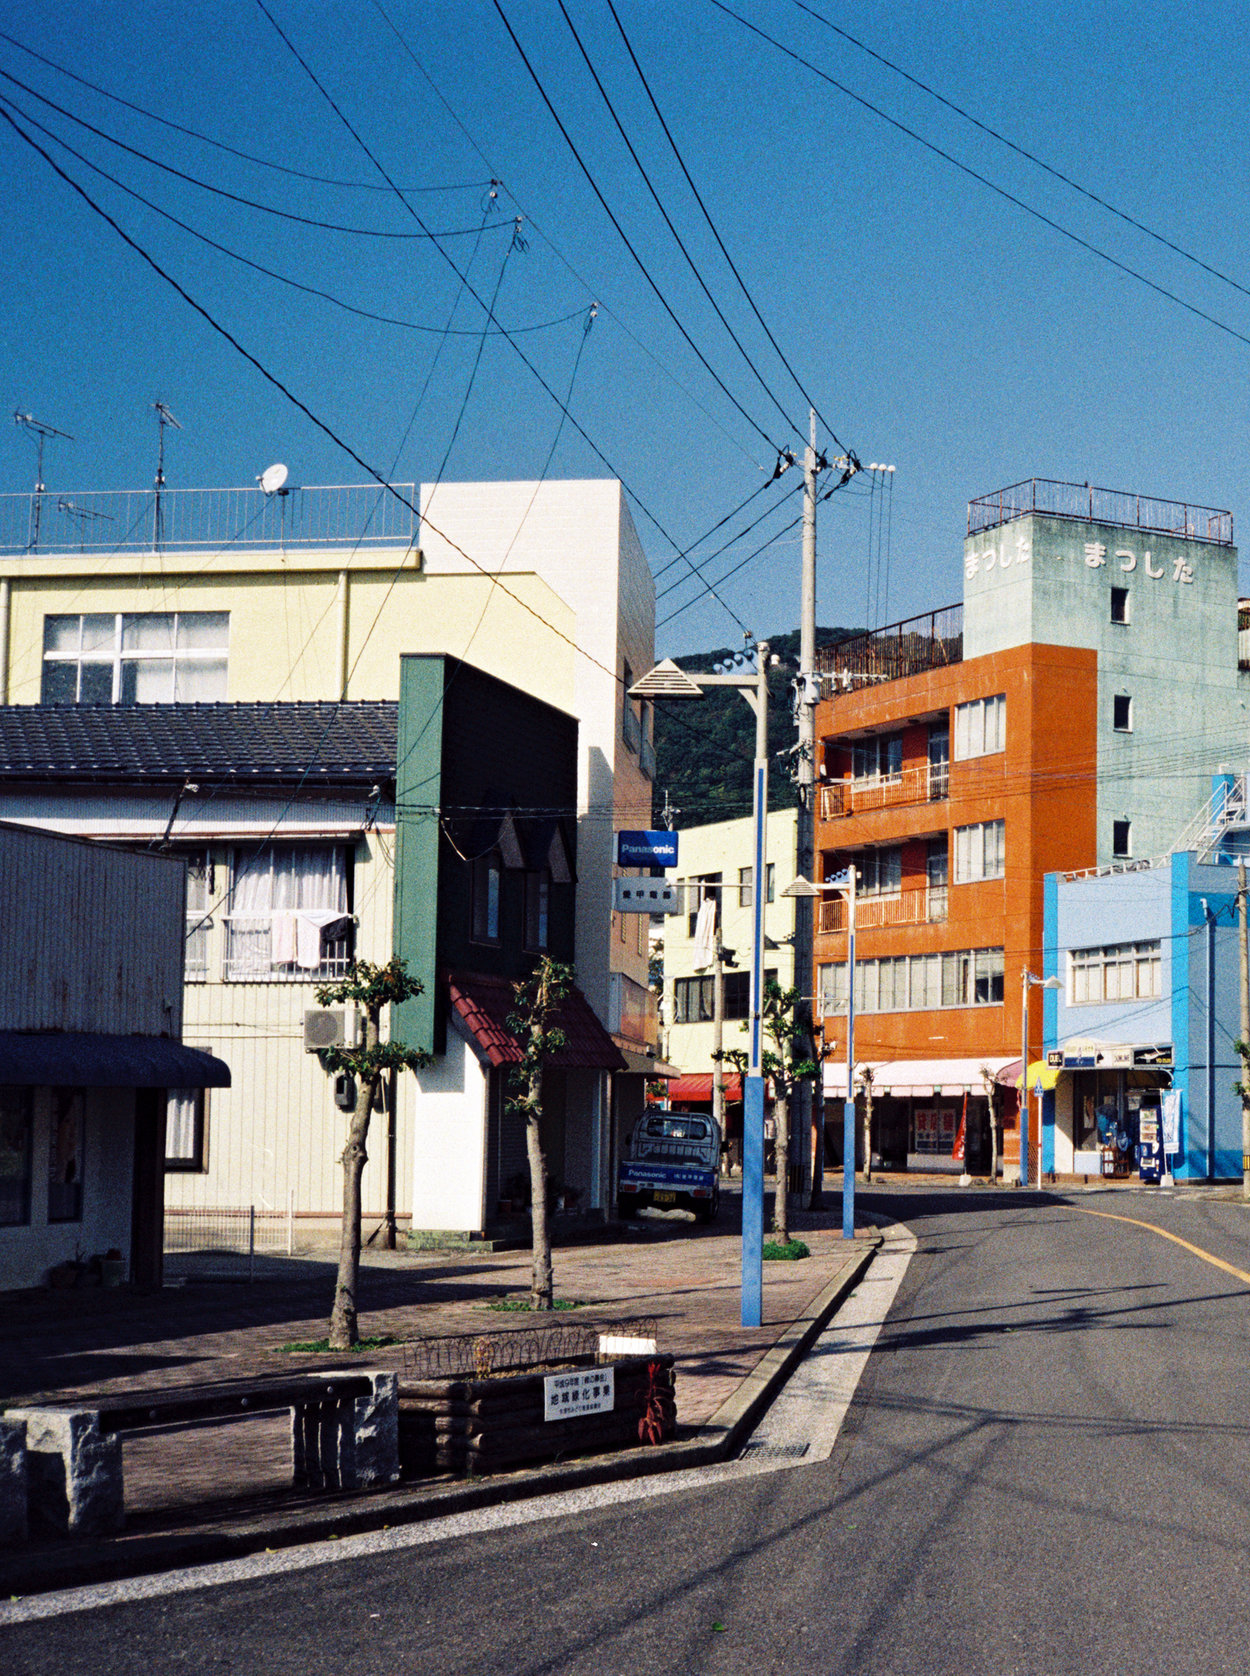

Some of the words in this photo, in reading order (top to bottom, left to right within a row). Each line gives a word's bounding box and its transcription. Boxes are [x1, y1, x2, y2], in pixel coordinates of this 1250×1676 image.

[965, 536, 1031, 580] まつした
[1084, 542, 1193, 584] まつした
[621, 844, 675, 854] Panasonic
[628, 1169, 667, 1179] Panasonic
